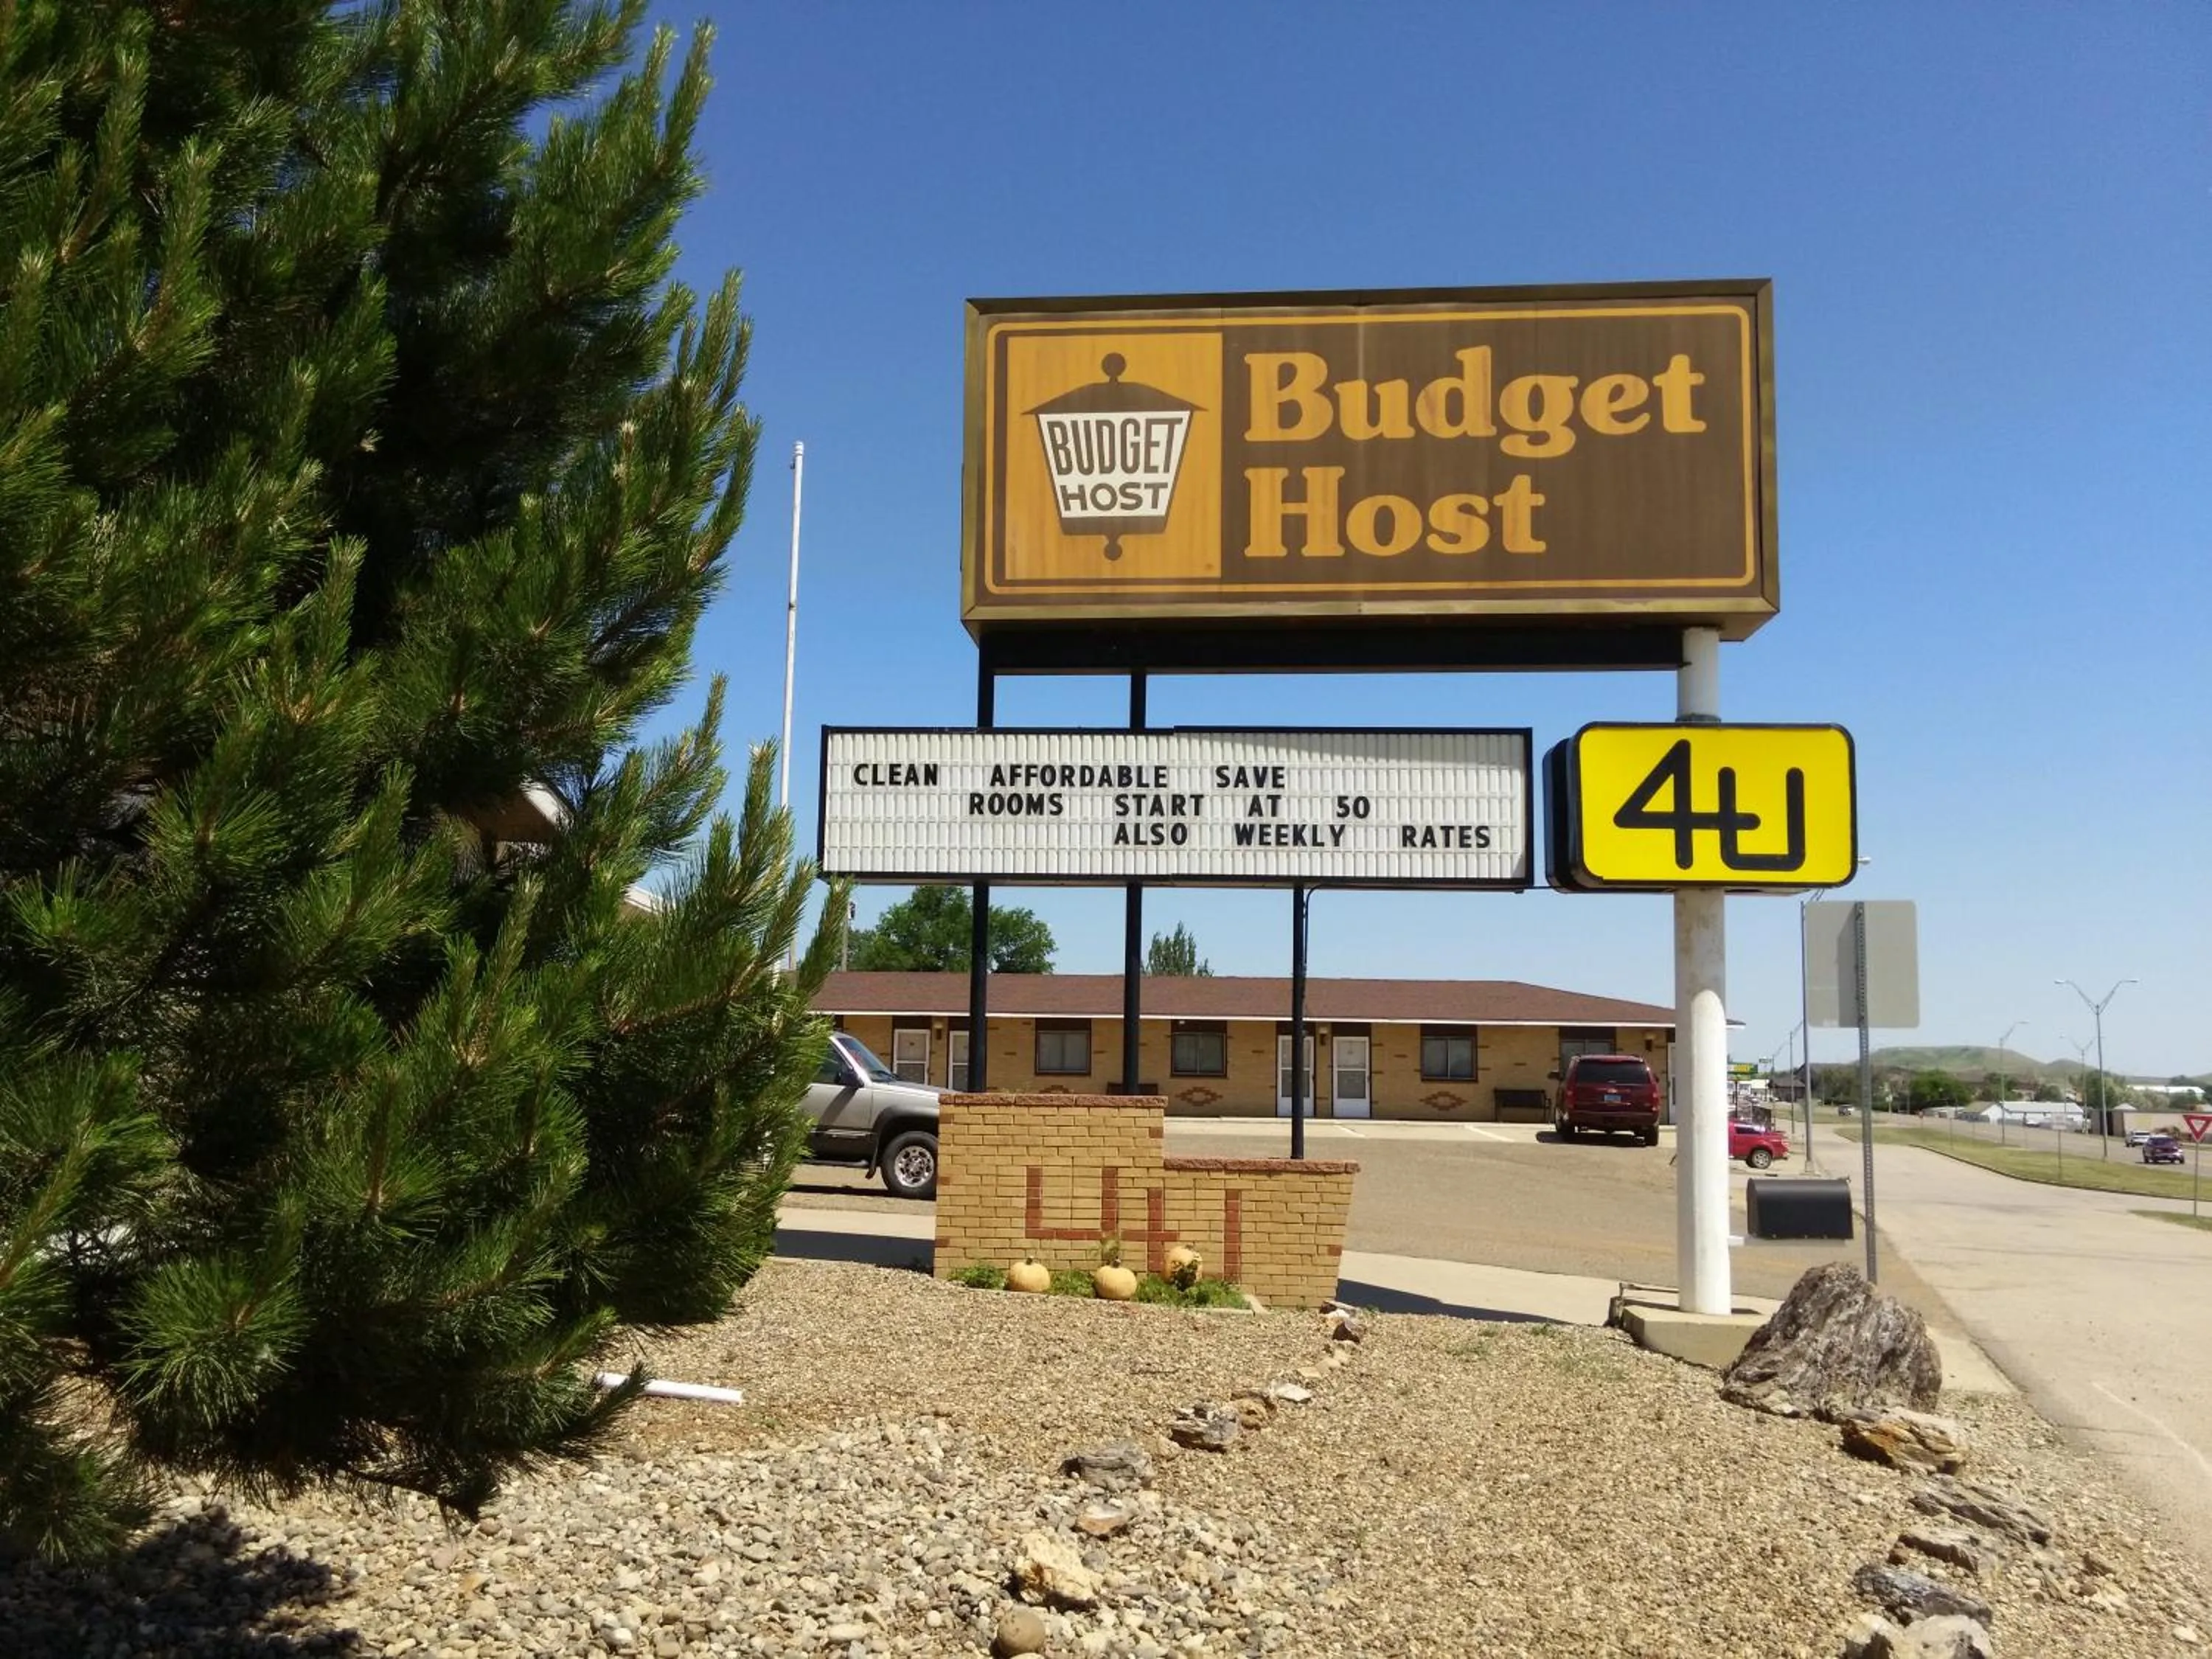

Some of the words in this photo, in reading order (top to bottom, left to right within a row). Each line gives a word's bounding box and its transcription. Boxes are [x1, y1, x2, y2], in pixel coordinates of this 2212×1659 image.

[1243, 344, 1706, 458] Budget
[1047, 417, 1183, 476] BUDGET
[1060, 482, 1168, 511] HOST
[1243, 465, 1547, 558] Host
[854, 764, 938, 786] CLEAN
[990, 765, 1168, 787] AFFORDABLE
[1216, 765, 1285, 788] SAVE
[969, 793, 1063, 815] ROOMS
[1115, 793, 1204, 817] START
[1248, 794, 1281, 817] AT
[1336, 796, 1370, 819] 50
[1613, 739, 1806, 872] 4U
[1114, 823, 1187, 846] ALSO
[1235, 824, 1346, 846] WEEKLY
[1402, 825, 1491, 848] RATES
